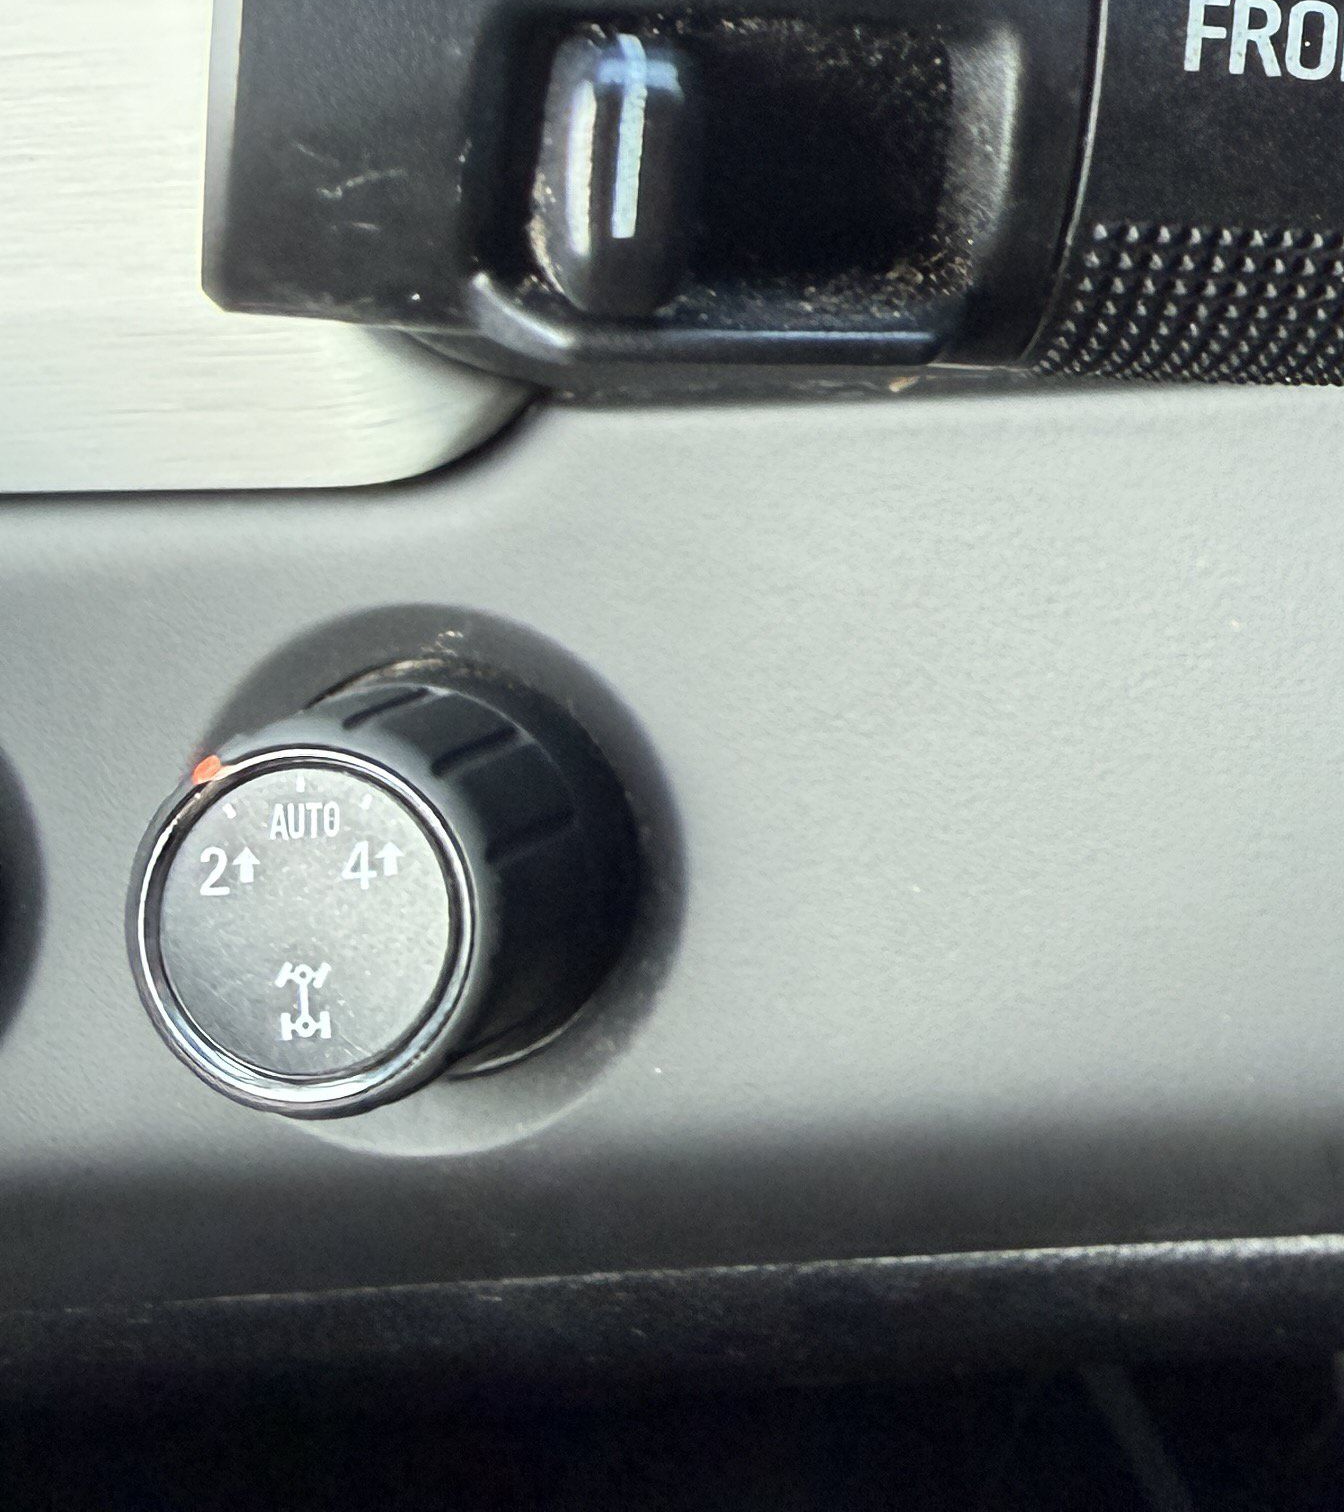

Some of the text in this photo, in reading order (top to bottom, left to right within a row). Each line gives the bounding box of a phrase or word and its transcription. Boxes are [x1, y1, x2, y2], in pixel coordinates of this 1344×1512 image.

[268, 800, 341, 842] AUTO
[199, 846, 231, 896] 2
[340, 840, 377, 891] 4
